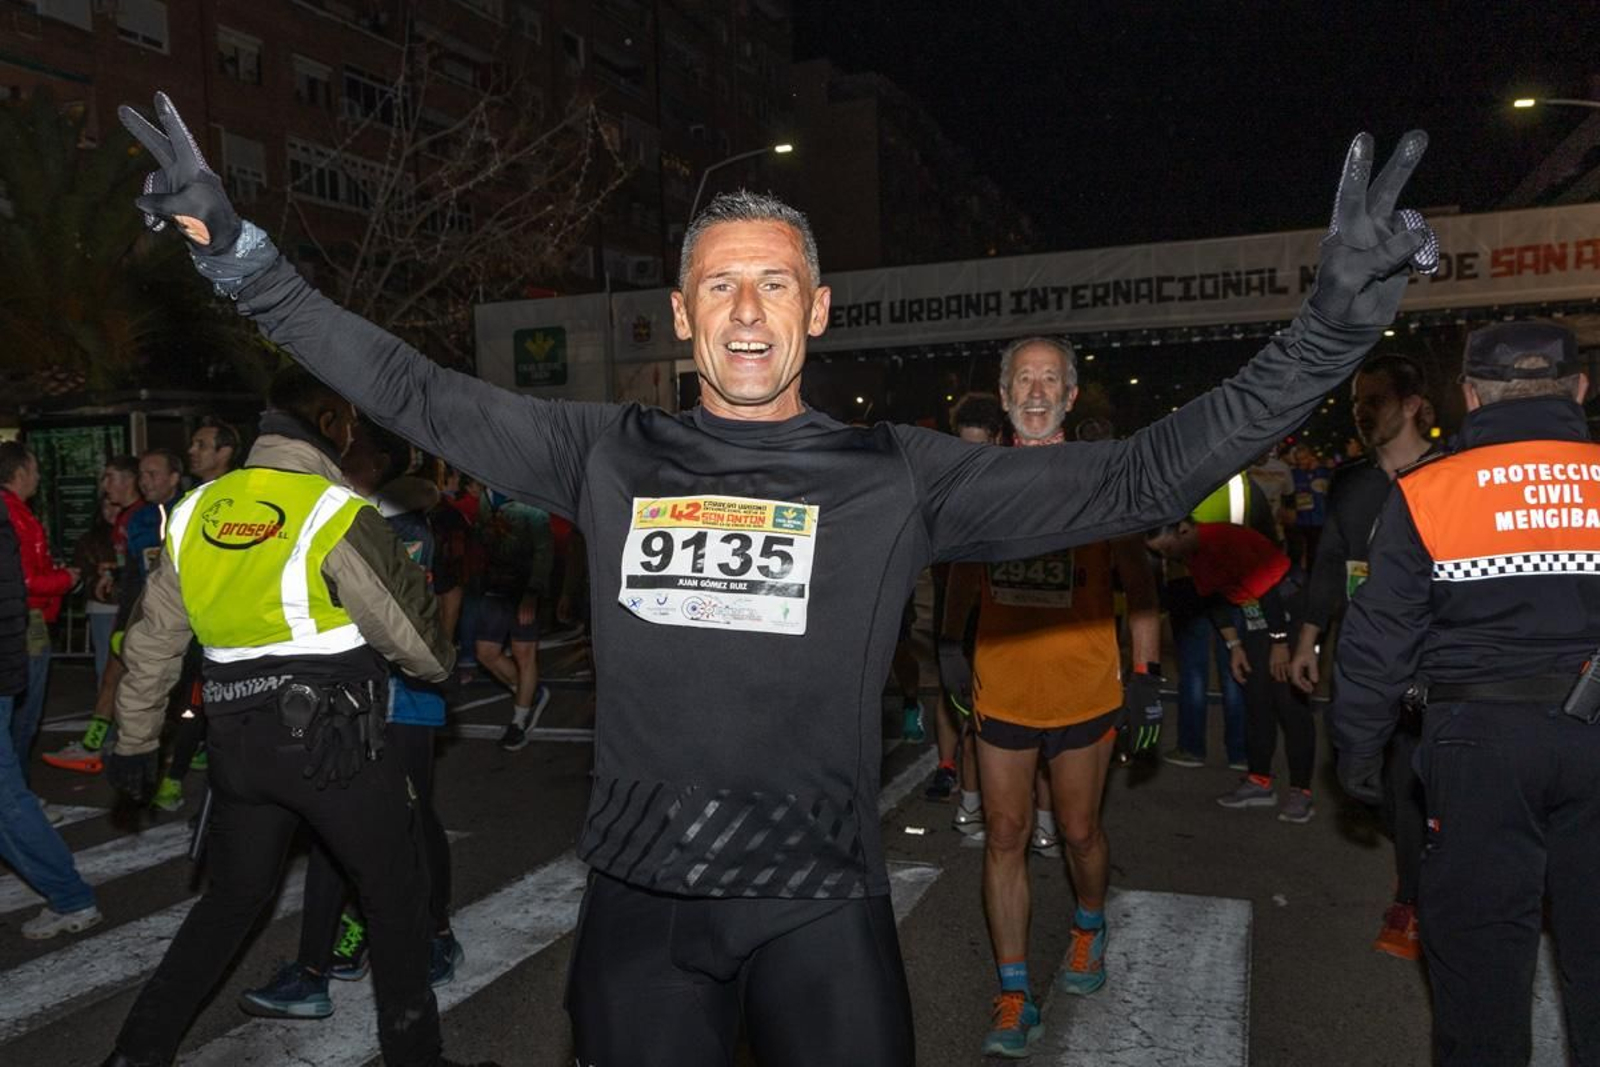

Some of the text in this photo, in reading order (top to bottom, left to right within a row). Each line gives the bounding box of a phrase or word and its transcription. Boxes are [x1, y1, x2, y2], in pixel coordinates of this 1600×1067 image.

[889, 290, 1001, 324] URBANA
[1009, 267, 1288, 315] INTERNACIONAL
[1491, 241, 1568, 278] SAN
[1524, 484, 1583, 505] CIVIL
[670, 501, 702, 522] 42
[701, 512, 725, 524] SAN
[1495, 508, 1600, 531] MENGIBA
[639, 530, 795, 580] 9135
[677, 578, 748, 591] JUAN GÓMEZ RUIZ
